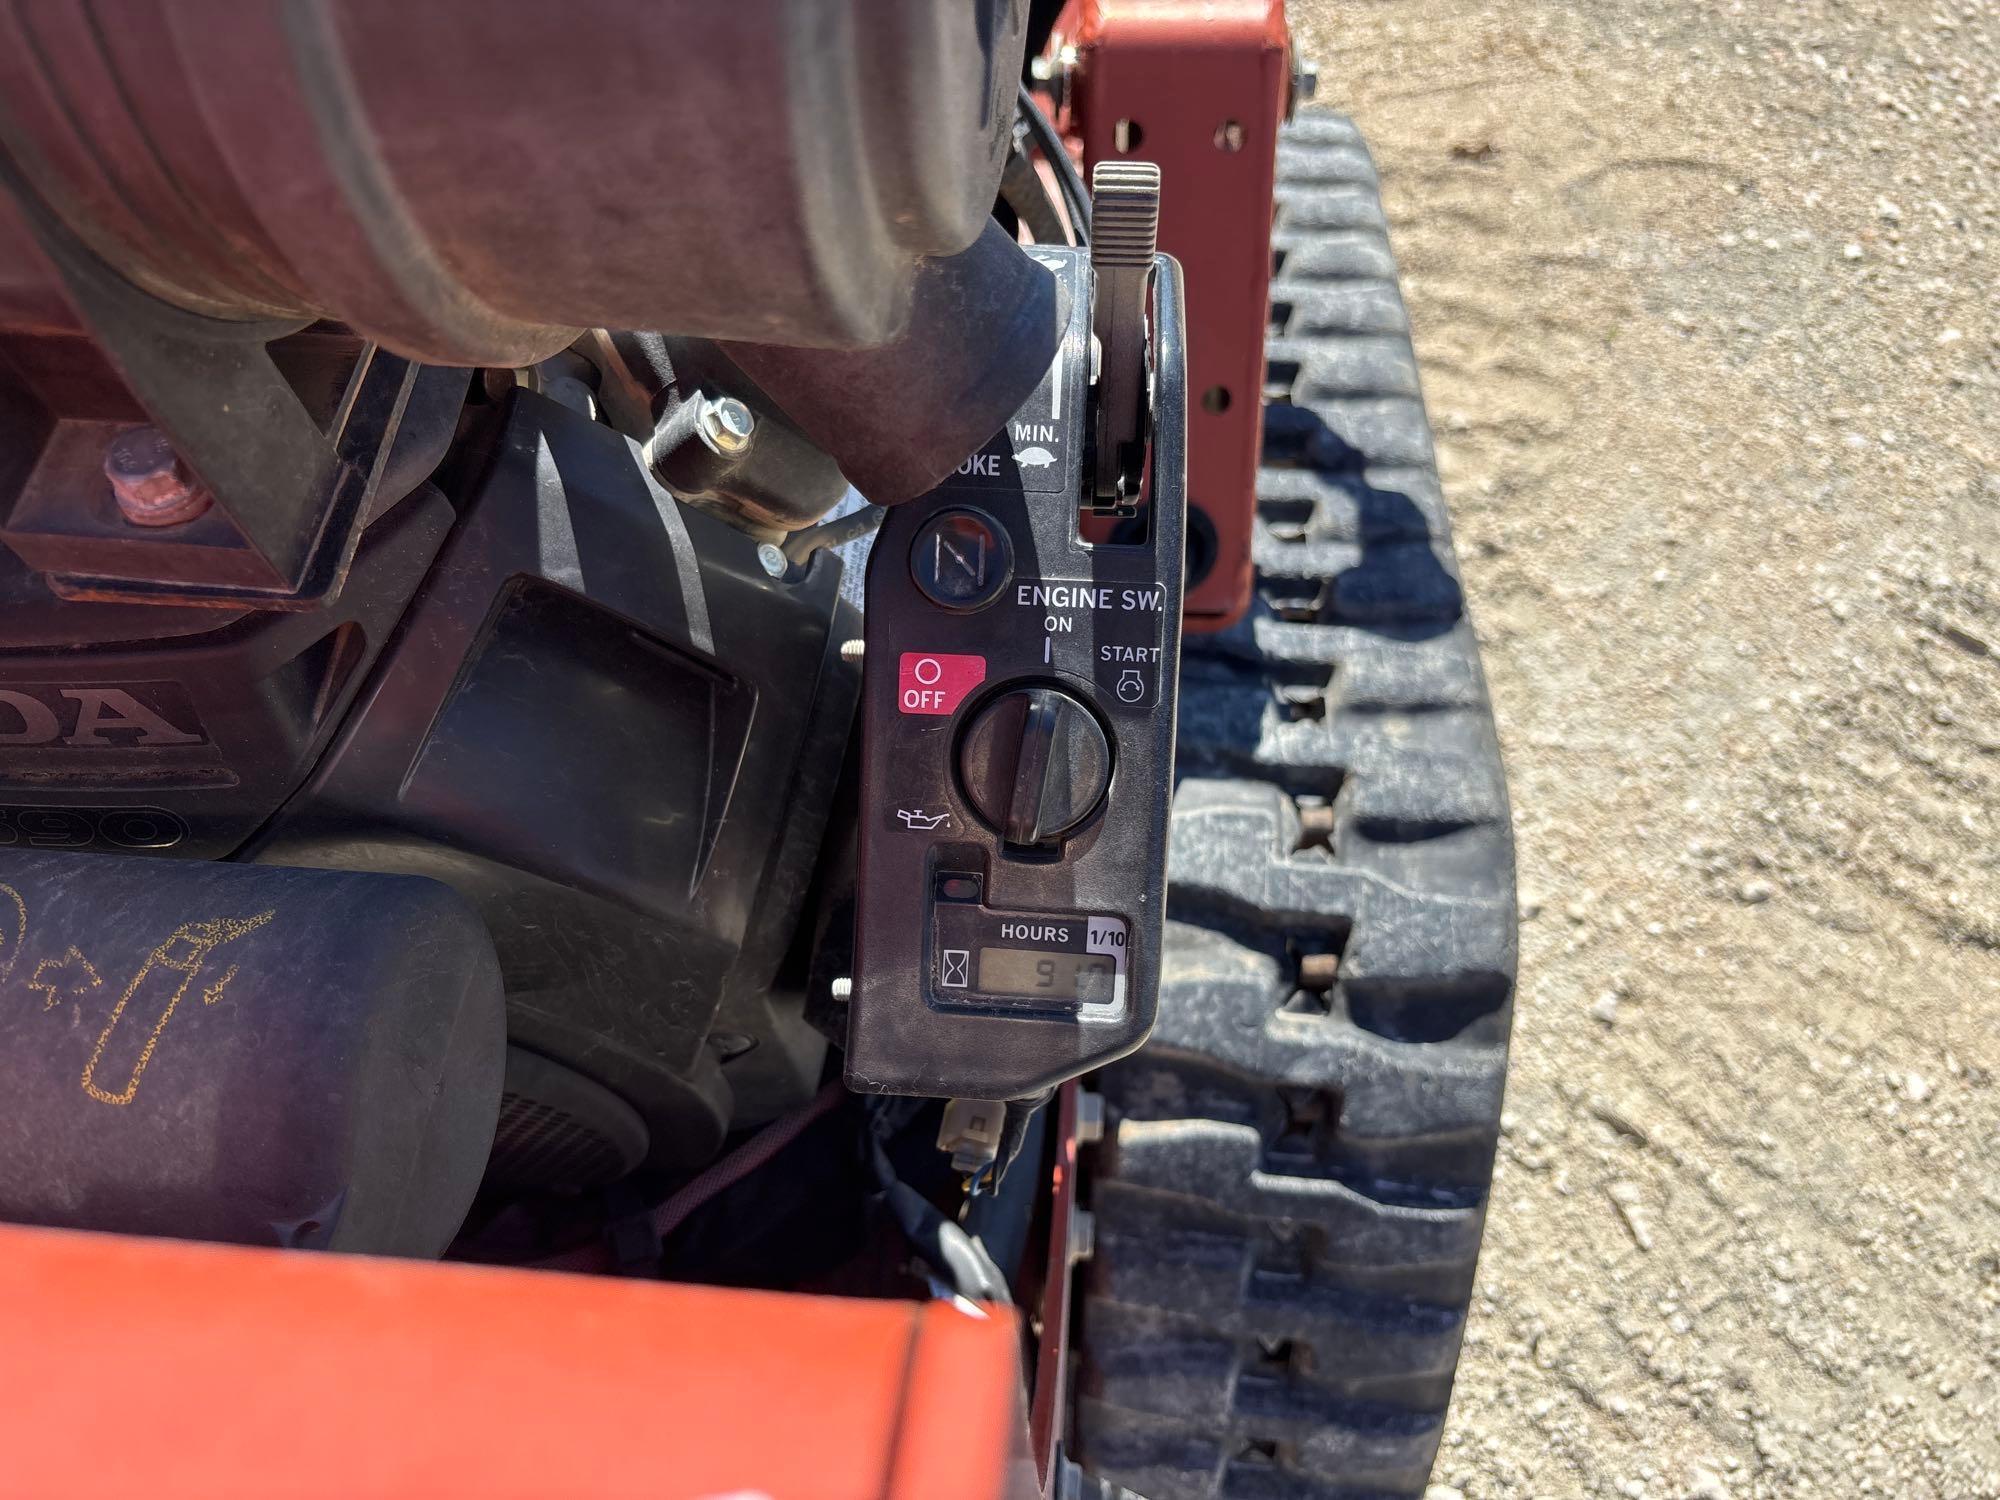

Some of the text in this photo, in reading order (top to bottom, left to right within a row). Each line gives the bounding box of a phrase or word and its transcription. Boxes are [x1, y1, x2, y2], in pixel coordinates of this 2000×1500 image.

[1015, 424, 1059, 443] MIN.
[1017, 585, 1163, 612] ENGINE SW.
[1044, 616, 1073, 633] ON
[1100, 646, 1161, 664] START
[903, 690, 946, 709] OFF
[0, 810, 184, 848] 90
[1001, 923, 1069, 943] HOURS
[1089, 929, 1125, 947] 1/10
